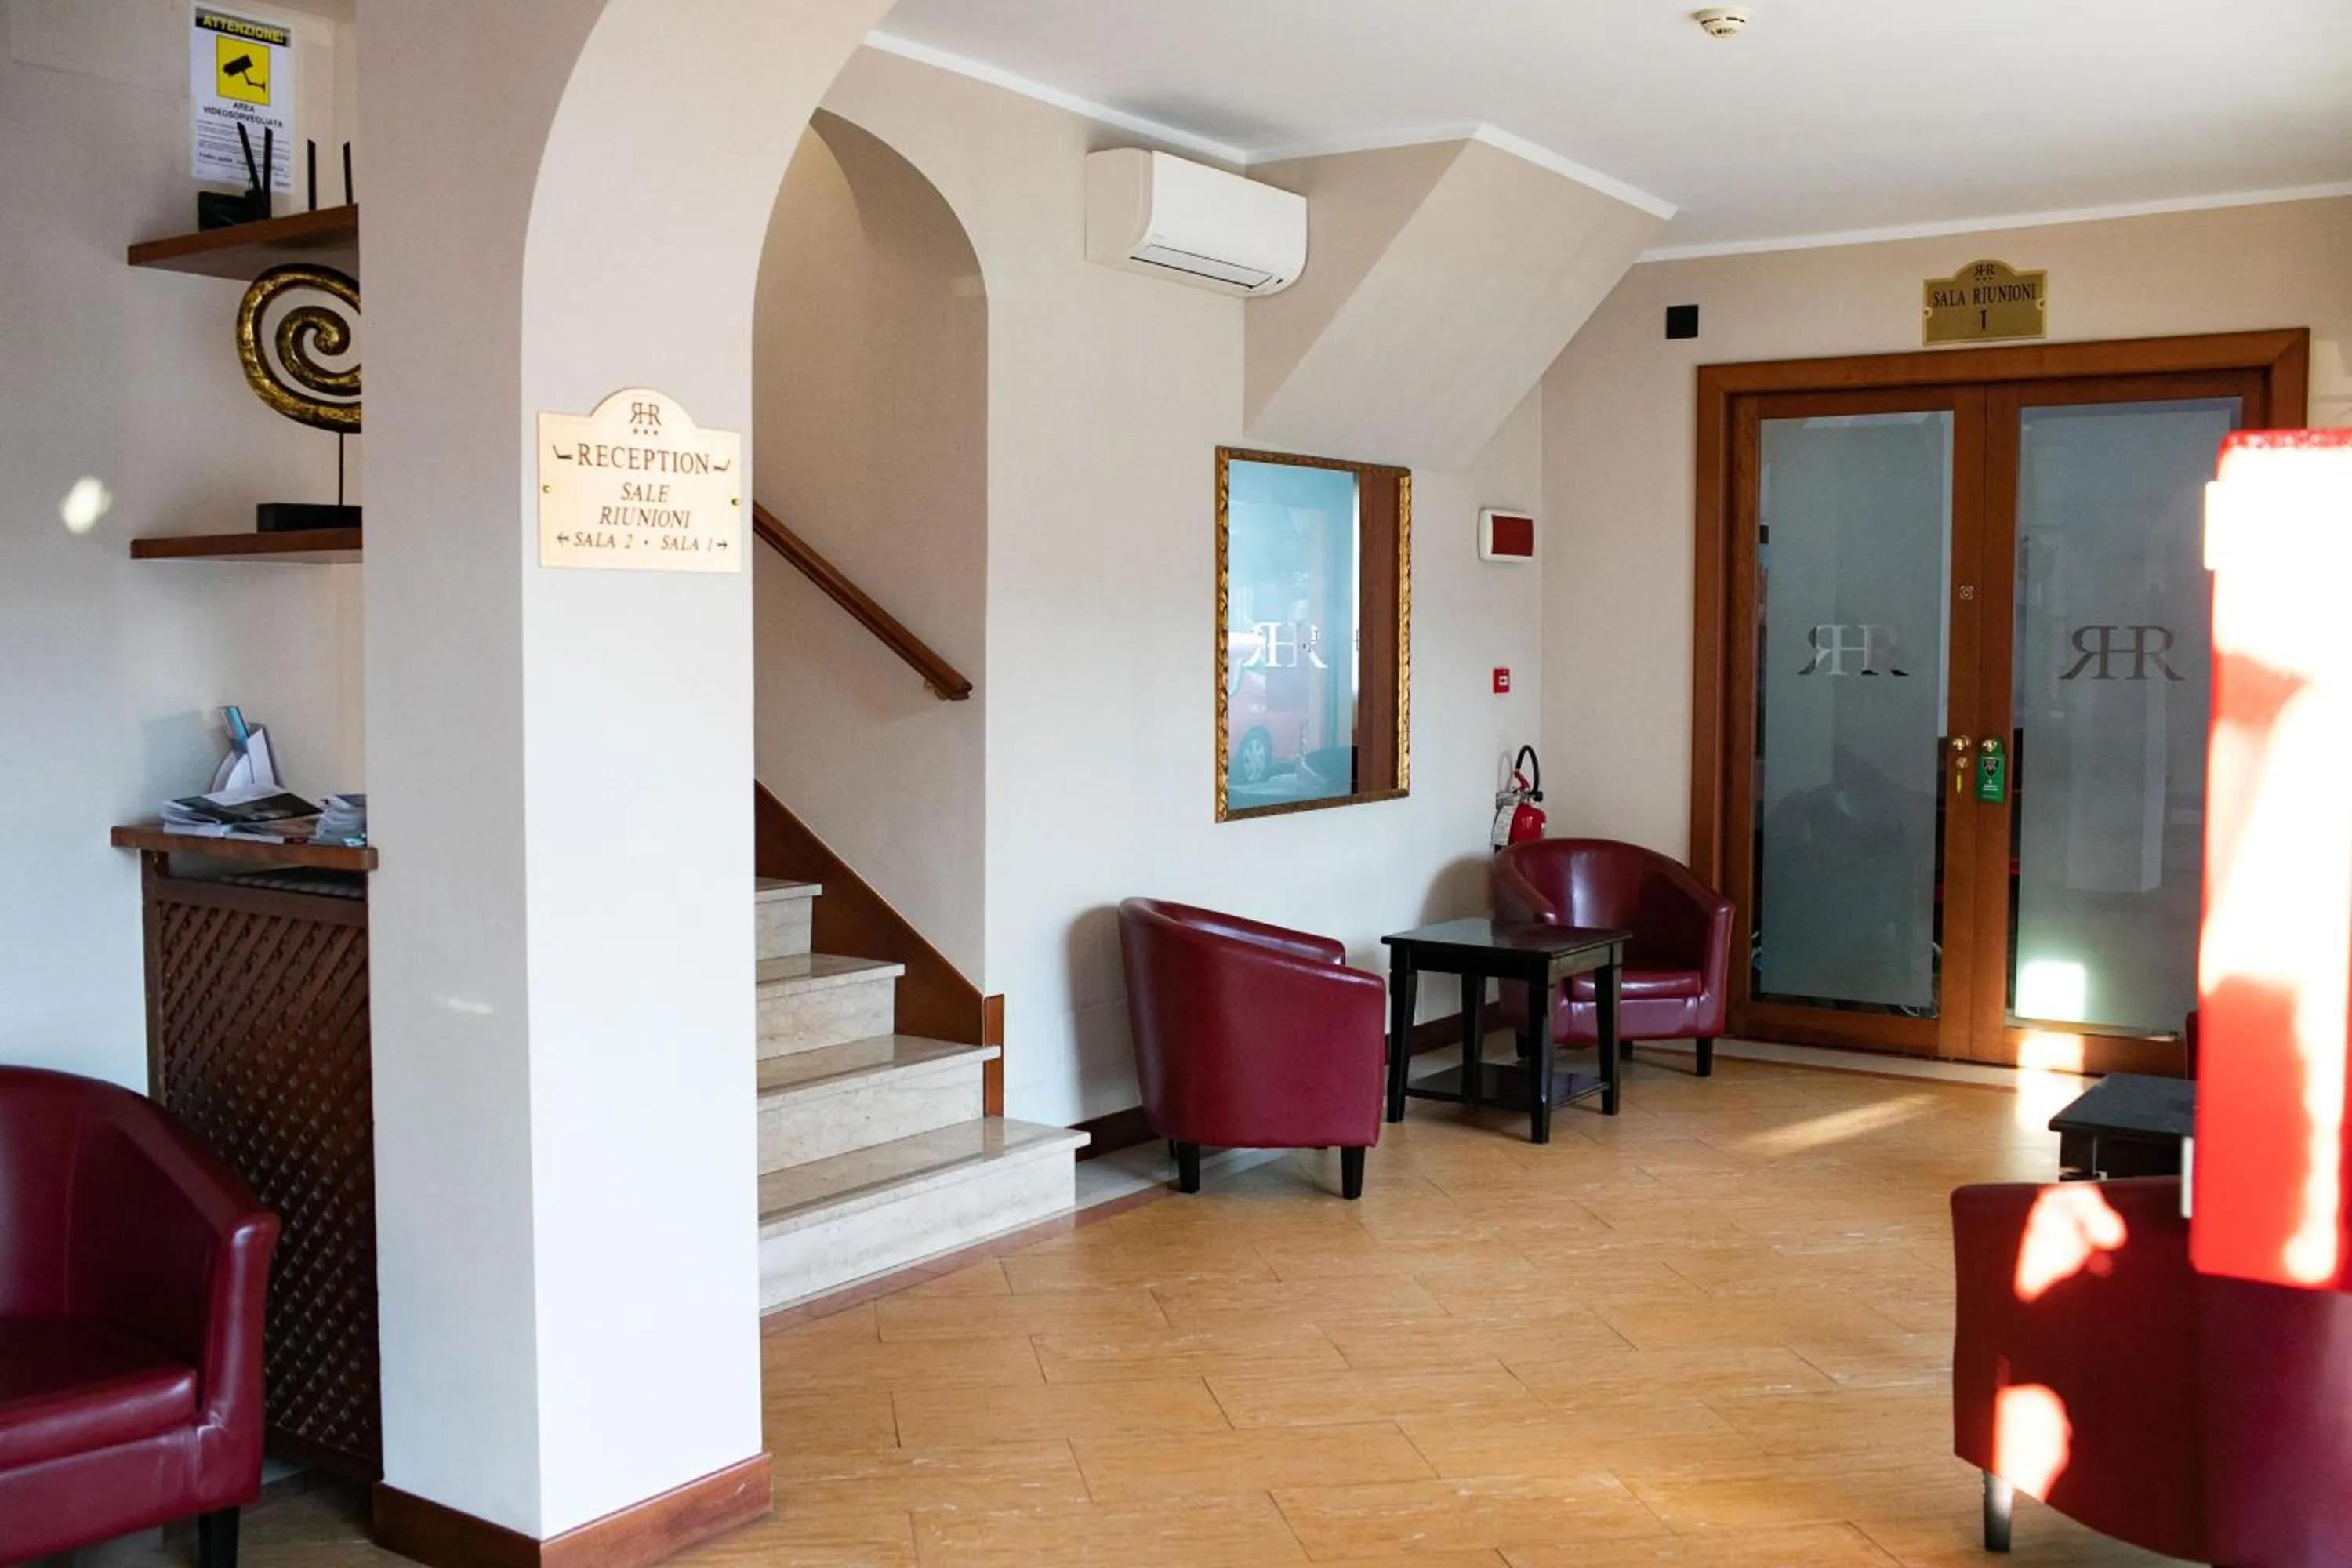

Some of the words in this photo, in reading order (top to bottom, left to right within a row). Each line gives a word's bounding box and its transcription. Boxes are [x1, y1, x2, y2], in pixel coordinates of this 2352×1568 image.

[203, 15, 284, 42] ATTENZIONE!
[203, 106, 283, 128] VIDEOSORVEGLIATA
[233, 102, 256, 113] AREA
[1933, 289, 1966, 308] SALA
[1973, 283, 2037, 305] RIUNIONI
[1980, 310, 1987, 331] 1
[577, 442, 710, 474] RECEPTION
[620, 481, 670, 503] SALE
[599, 506, 691, 529] RIUNIONI
[573, 531, 616, 548] SALA
[625, 534, 633, 549] 2
[660, 535, 699, 551] SALA
